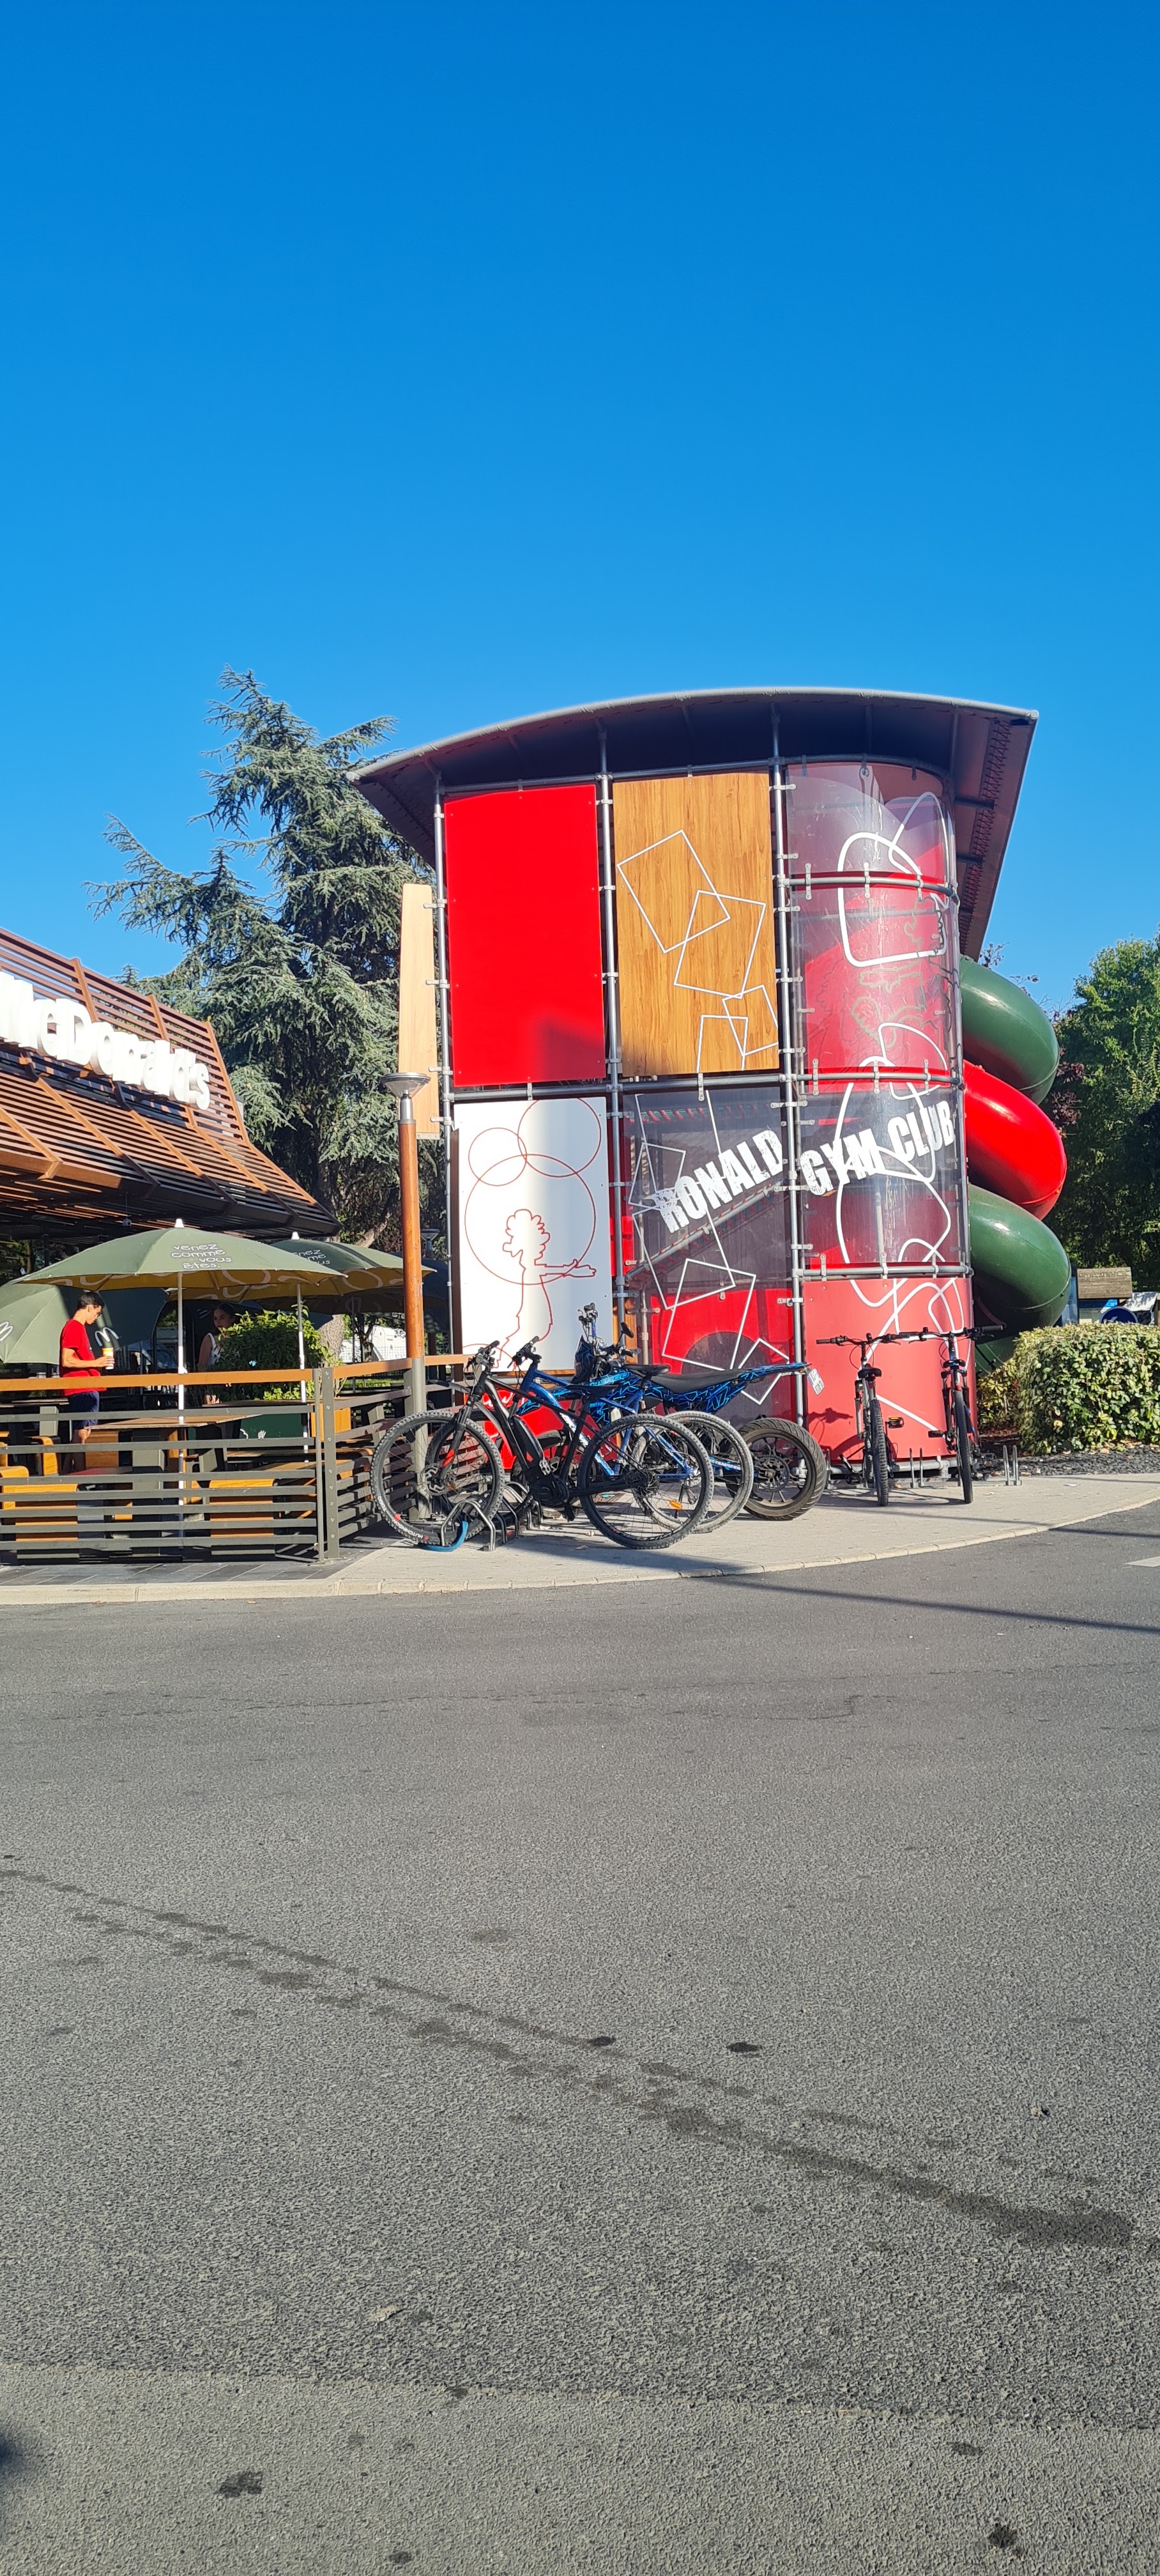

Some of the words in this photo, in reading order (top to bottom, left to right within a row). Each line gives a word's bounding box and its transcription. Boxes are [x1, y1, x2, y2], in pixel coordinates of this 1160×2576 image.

[653, 1129, 784, 1234] RONALD
[799, 1128, 885, 1196] GYM
[887, 1100, 956, 1162] CLUB
[172, 1243, 219, 1252] venez
[171, 1249, 225, 1258] comme
